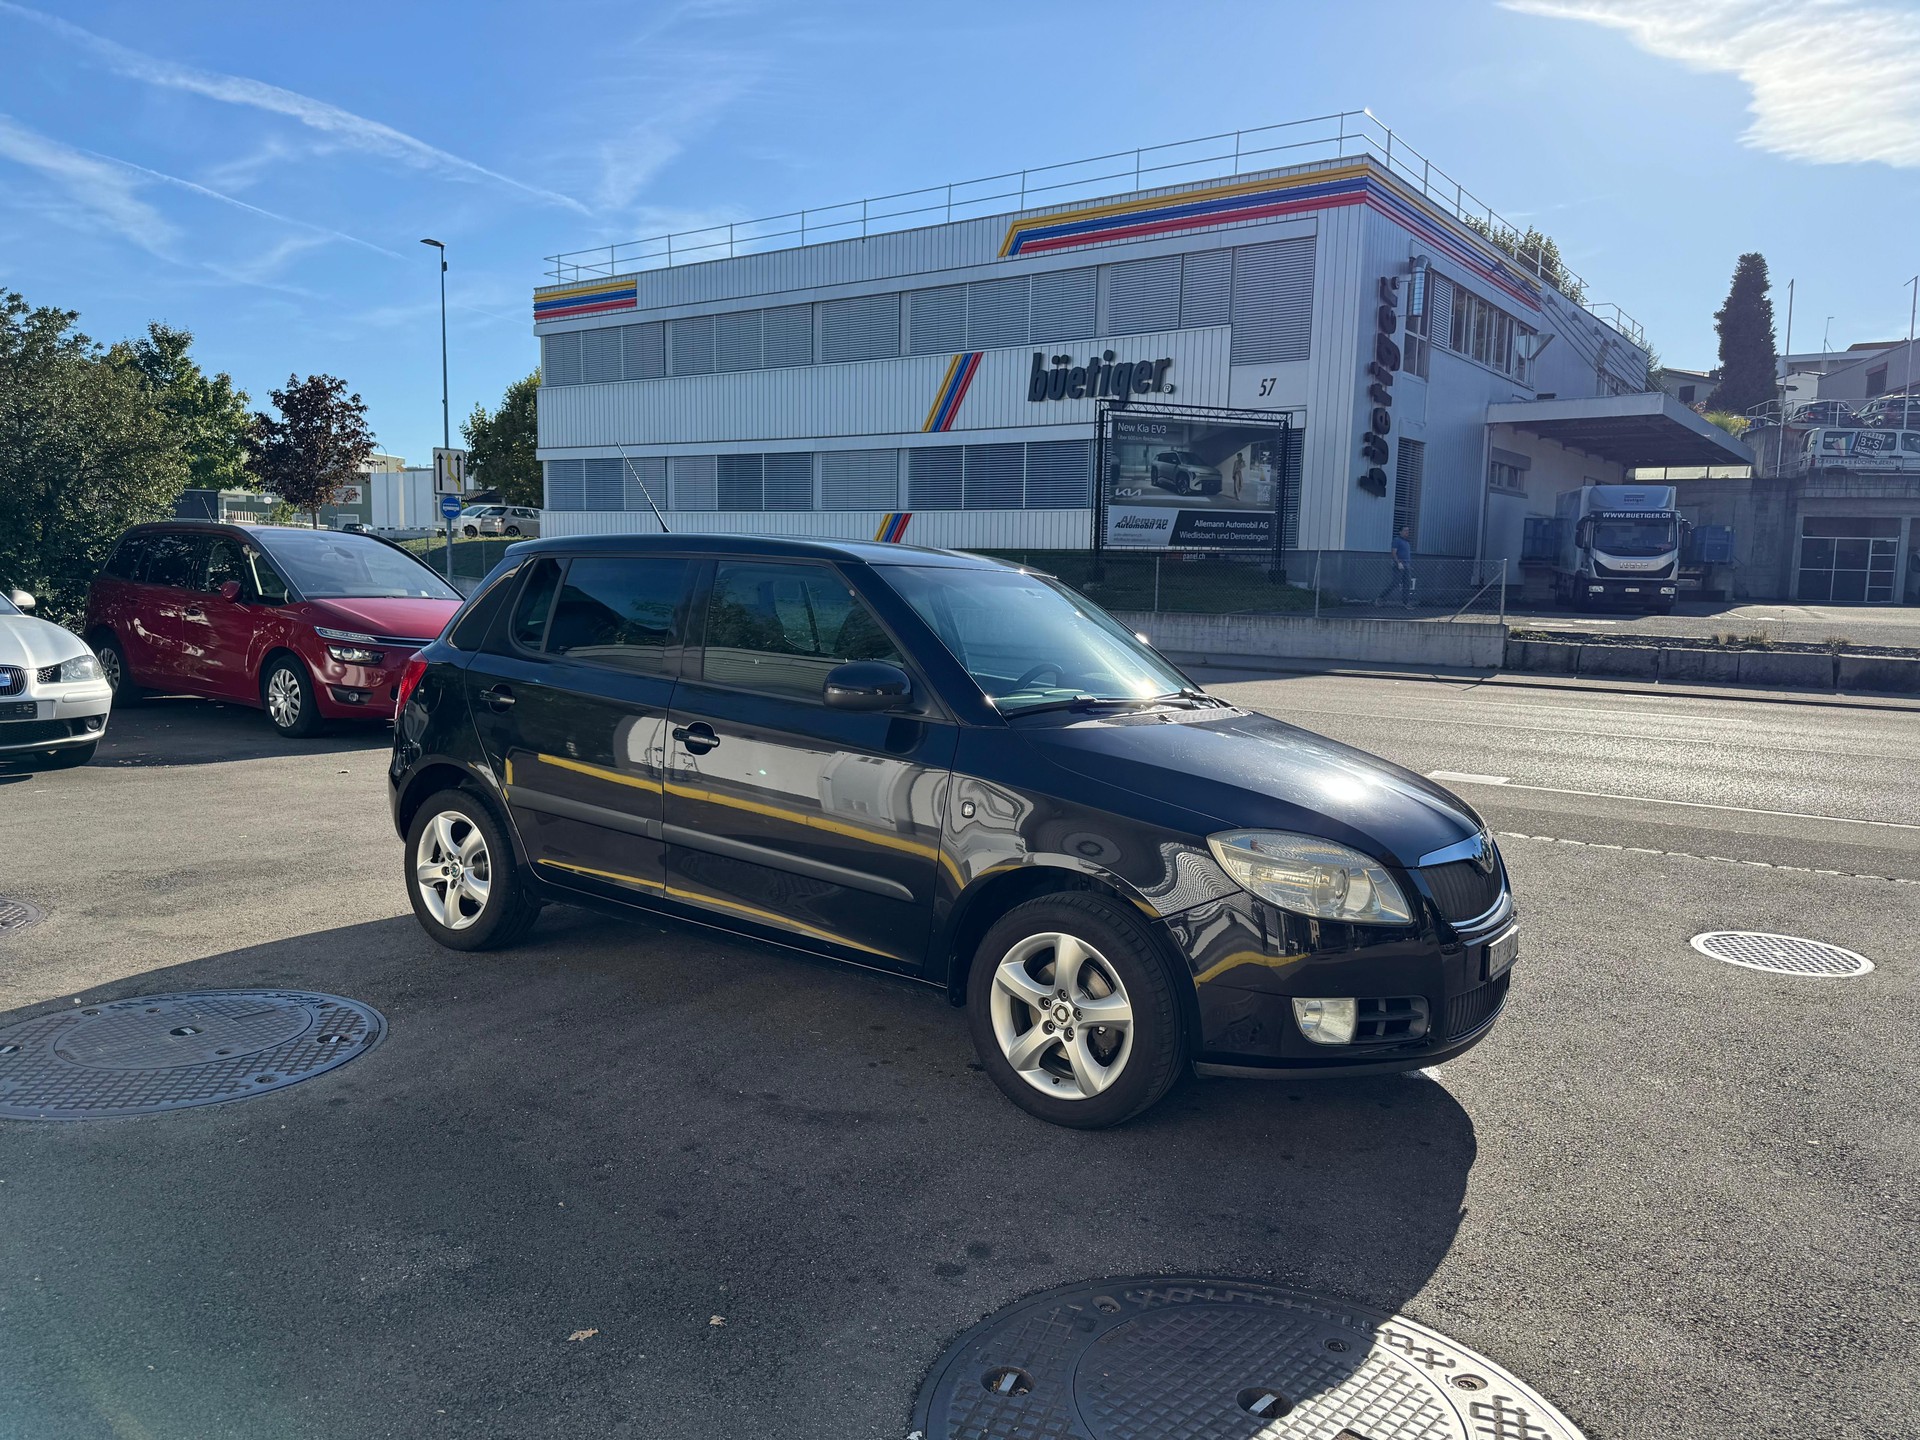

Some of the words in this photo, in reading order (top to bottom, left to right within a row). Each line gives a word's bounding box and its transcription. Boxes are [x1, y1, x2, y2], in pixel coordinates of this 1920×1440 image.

[1028, 350, 1172, 409] büetiger
[1259, 377, 1277, 396] 57
[1359, 276, 1400, 498] büetiger
[1117, 423, 1135, 432] New
[1137, 423, 1149, 433] Kia
[1151, 424, 1167, 434] EV3
[1859, 437, 1880, 449] B+S
[1114, 522, 1154, 530] Automobil
[1120, 515, 1169, 525] Allemann
[1194, 520, 1225, 528] Allemann
[1225, 521, 1258, 529] Automobil
[1259, 521, 1269, 529] AG
[1179, 530, 1216, 539] Wiedlisbach
[1217, 532, 1230, 540] und
[1230, 532, 1269, 542] Derendingen
